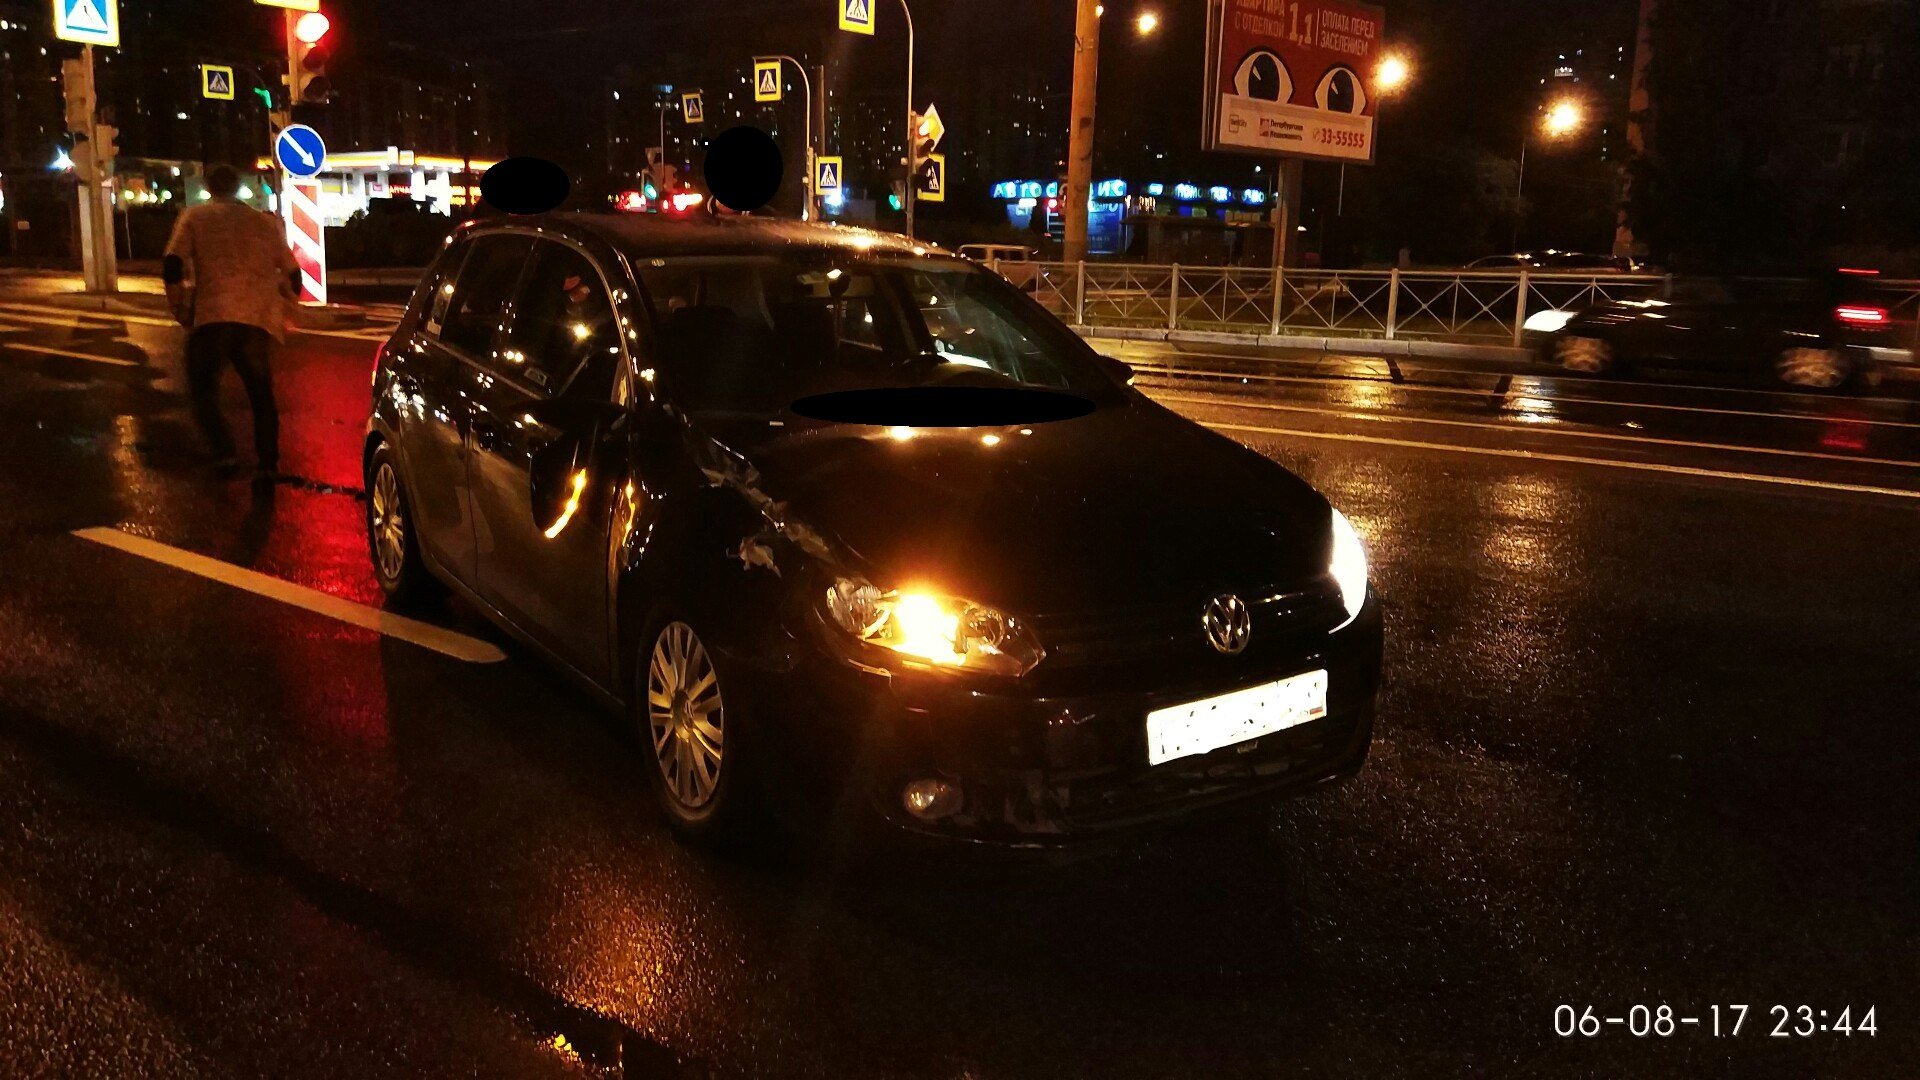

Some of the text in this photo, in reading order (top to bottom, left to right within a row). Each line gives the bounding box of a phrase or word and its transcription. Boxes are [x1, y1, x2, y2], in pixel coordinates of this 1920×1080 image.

[1289, 2, 1312, 46] 1,1
[1322, 9, 1376, 39] ОПЛАТА ПЕРЕД
[1320, 30, 1369, 56] ЗАСЕЛЕНИЕМ
[1321, 128, 1365, 148] 33-55555
